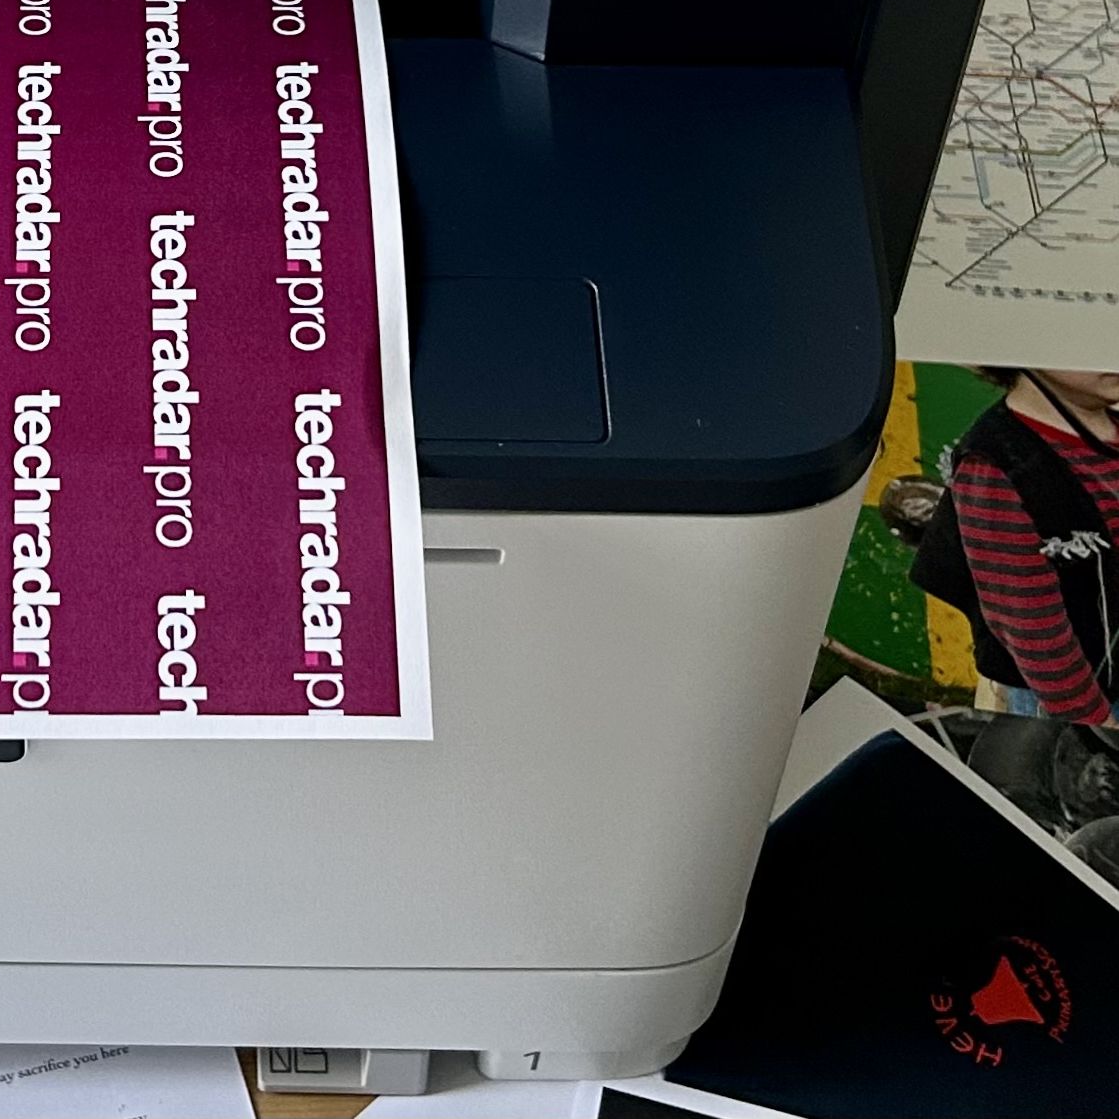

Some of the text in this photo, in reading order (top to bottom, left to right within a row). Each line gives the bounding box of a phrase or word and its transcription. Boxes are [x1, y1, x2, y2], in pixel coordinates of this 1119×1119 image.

[4, 61, 62, 352] techradar.pro
[276, 62, 329, 350] techradar.pro
[144, 211, 199, 547] techradar.pro
[18, 1057, 71, 1079] sacrifice
[72, 1052, 98, 1070] you
[100, 1045, 129, 1060] here
[523, 1051, 540, 1071] 1
[931, 978, 1002, 1066] HEVE
